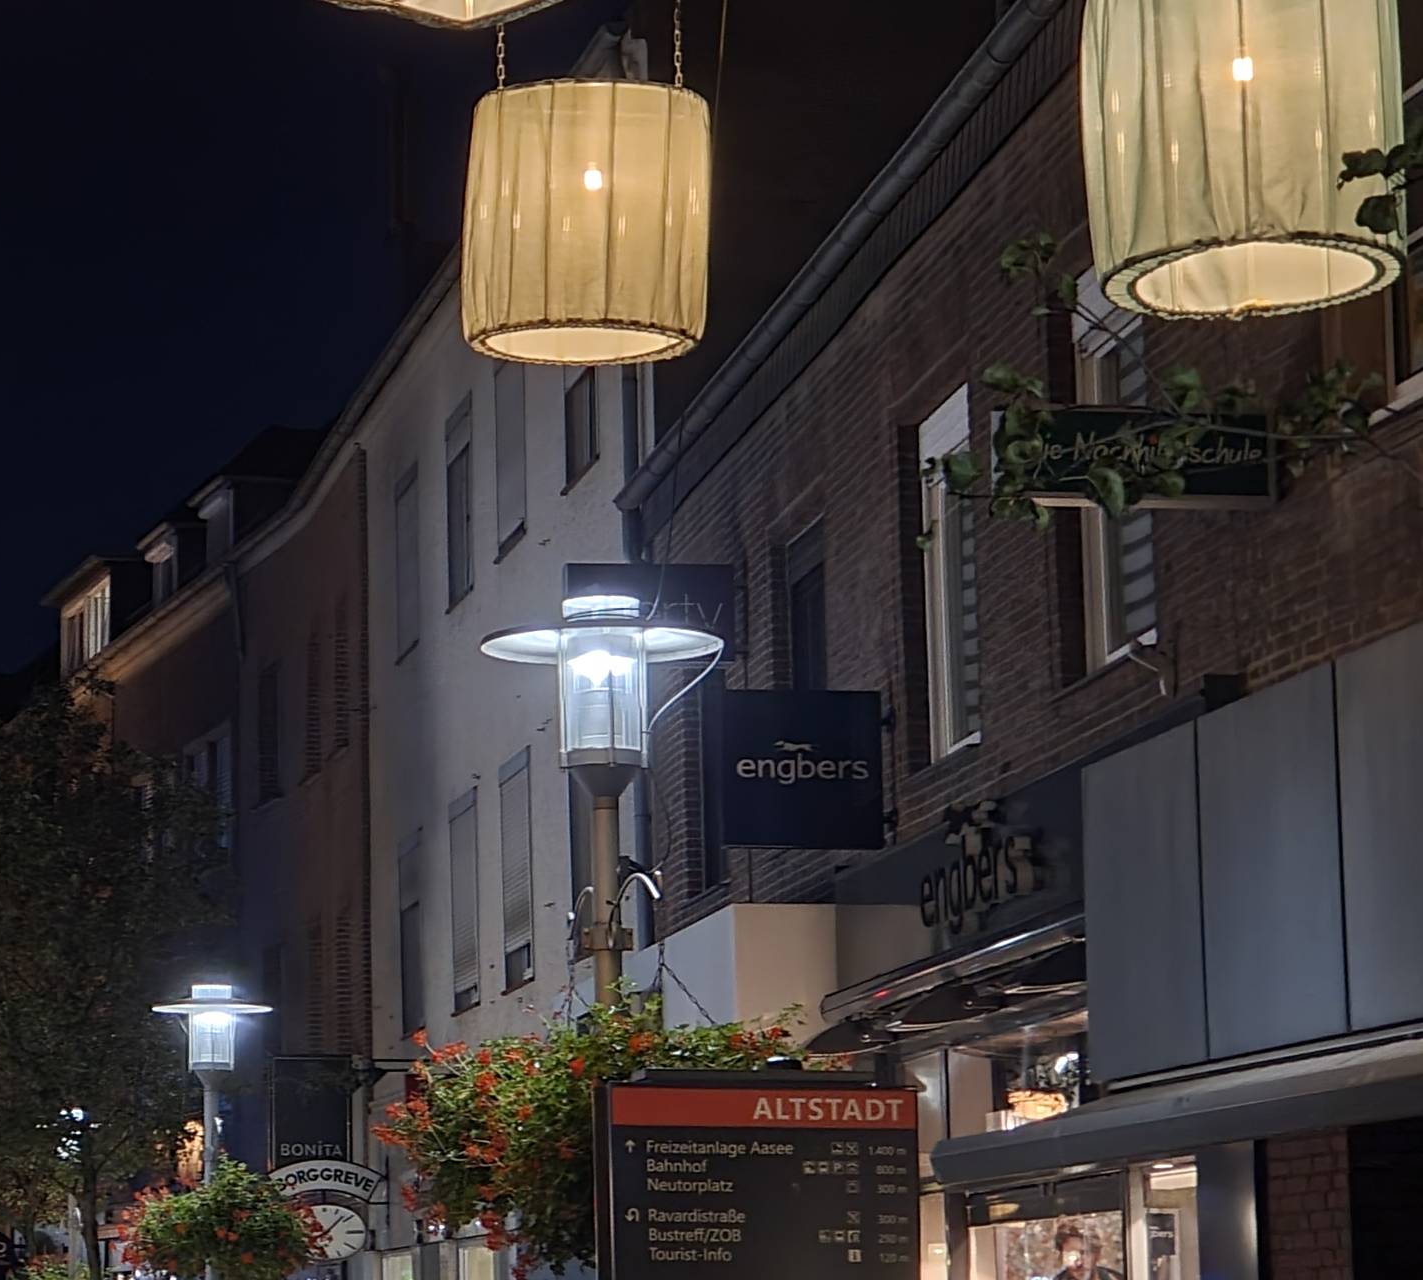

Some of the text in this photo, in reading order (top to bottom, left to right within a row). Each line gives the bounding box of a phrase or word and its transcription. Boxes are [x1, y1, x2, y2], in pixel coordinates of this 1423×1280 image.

[736, 752, 869, 785] engbers
[920, 830, 1017, 934] engbers
[753, 1097, 904, 1121] ALTSTADT
[646, 1140, 746, 1157] Freizeitanlage
[750, 1141, 794, 1155] Aasee
[646, 1159, 708, 1173] Bahnhof
[647, 1178, 734, 1194] Neutorplatz
[648, 1208, 746, 1223] Ravardistraße
[648, 1228, 742, 1243] Bustreff/ZOB
[650, 1247, 732, 1261] Tourist-Info
